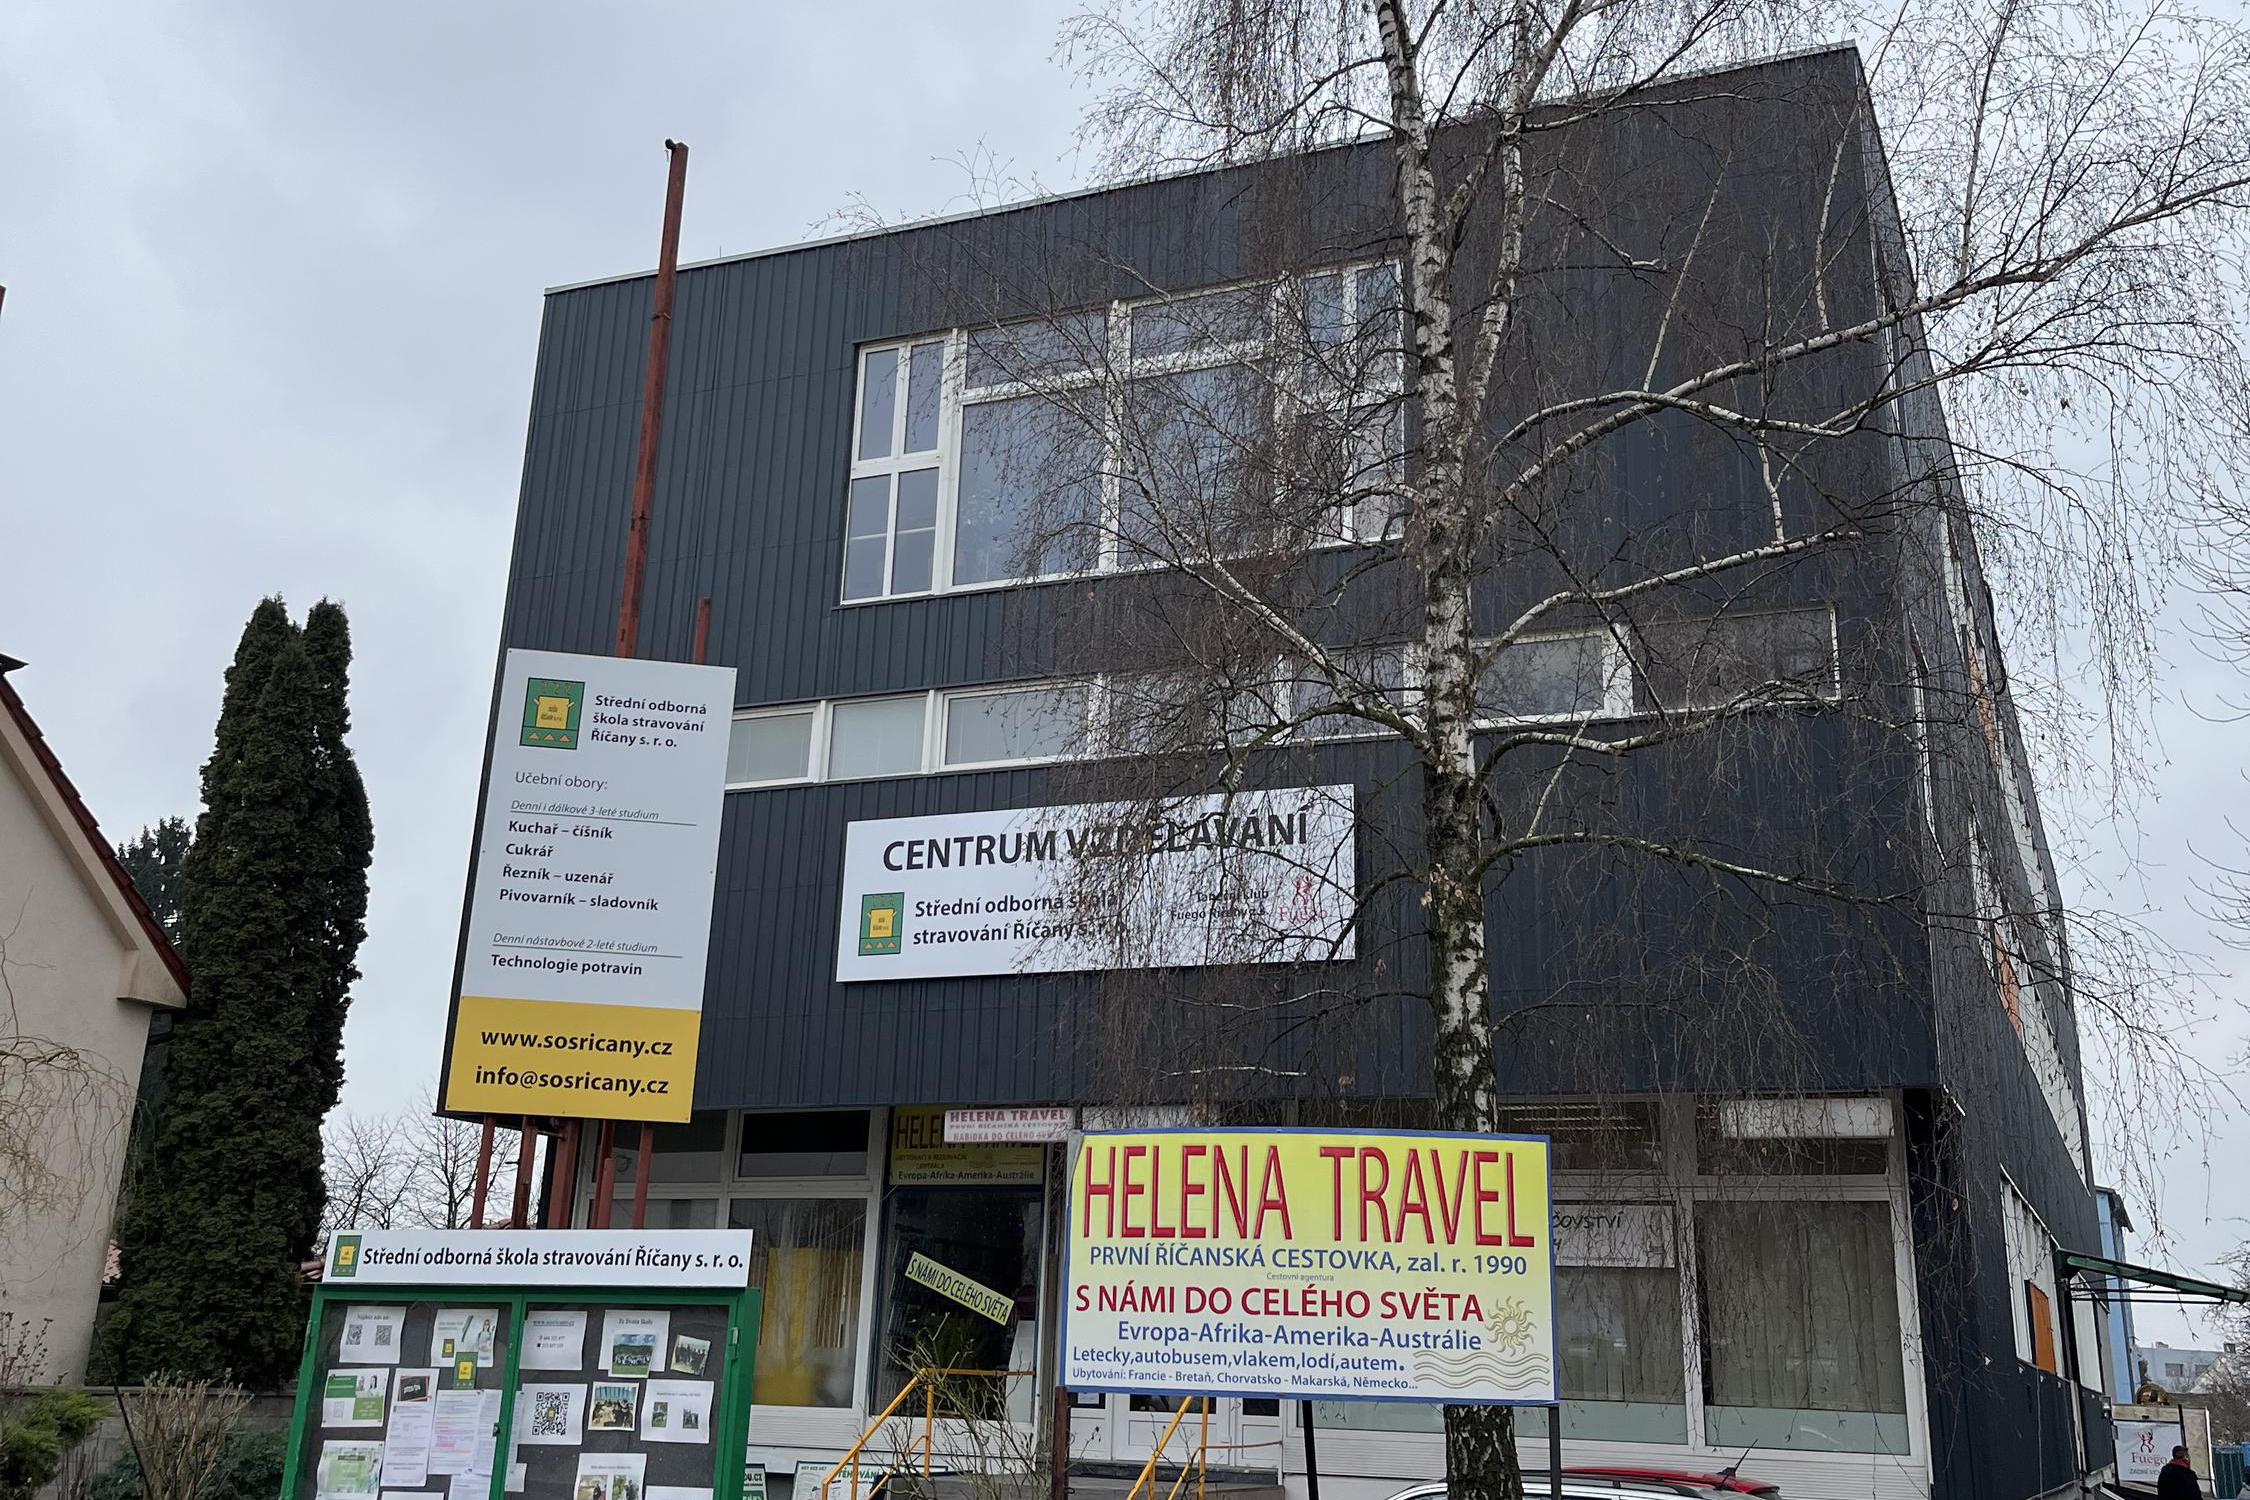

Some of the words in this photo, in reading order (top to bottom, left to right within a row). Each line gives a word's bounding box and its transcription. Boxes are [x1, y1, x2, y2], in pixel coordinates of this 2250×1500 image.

[595, 694, 645, 711] Střední
[648, 701, 707, 716] odborná
[592, 712, 629, 727] škola
[632, 716, 705, 733] stravování
[591, 729, 637, 746] Říčany
[639, 735, 650, 746] s.
[653, 736, 663, 747] r.
[665, 736, 678, 748] o.
[515, 771, 562, 787] Učební
[564, 775, 608, 792] obory:
[511, 800, 541, 812] Denní
[547, 803, 588, 816] dálkové
[589, 806, 617, 818] 3-leté
[618, 808, 659, 820] studium
[508, 820, 559, 836] Kuchař
[571, 823, 613, 839] číšník
[505, 842, 554, 858] Cukrář
[883, 830, 1056, 871] CENTRUM
[502, 866, 551, 881] Řezník
[564, 870, 615, 885] uzenář
[499, 888, 575, 906] Pivovarník
[589, 895, 659, 911] sladovník
[915, 895, 981, 918] Střední
[984, 891, 1064, 915] odborná
[912, 921, 1008, 945] stravování
[1012, 915, 1075, 941] Říčany
[493, 932, 525, 945] Denní
[526, 935, 584, 949] nástavbové
[586, 939, 615, 951] 2-leté
[616, 941, 658, 953] studium
[491, 954, 579, 973] Technologie
[581, 960, 643, 976] potravin
[480, 1031, 674, 1059] www.sosricany.cz
[475, 1065, 670, 1097] info@sosricany.cz
[950, 1110, 1006, 1123] HELENA
[1010, 1109, 1067, 1121] TRAVEL
[1083, 1145, 1293, 1241] HELENA
[1320, 1145, 1535, 1249] TRAVEL
[363, 1246, 420, 1266] Střední
[423, 1246, 492, 1266] odborná
[495, 1246, 540, 1267] škola
[542, 1247, 631, 1268] stravování
[633, 1243, 693, 1273] Říčany
[695, 1253, 709, 1269] s.
[713, 1253, 724, 1269] r.
[728, 1254, 744, 1270] o.
[1090, 1242, 1152, 1266] PRVNÍ
[1155, 1240, 1266, 1269] ŘÍČANSKÁ
[1272, 1247, 1402, 1275] CESTOVKA,
[1406, 1252, 1446, 1274] zal.
[1452, 1258, 1468, 1275] r.
[1474, 1254, 1528, 1276] 1990
[908, 1258, 918, 1275] S
[915, 1261, 940, 1286] NÁMI
[936, 1272, 952, 1293] DO
[950, 1280, 984, 1309] CELÉHO
[980, 1295, 1010, 1322] SVĚTA
[1075, 1284, 1091, 1312] S
[1098, 1278, 1176, 1314] NÁMI
[1185, 1286, 1232, 1316] DO
[1240, 1282, 1371, 1319] CELÉHO
[1379, 1286, 1485, 1323] SVĚTA
[1118, 1321, 1482, 1352] Evropa-Afrika-Amerika-Austrálie
[1072, 1368, 1127, 1383] Ubytování:
[1128, 1369, 1167, 1383] Francie
[1175, 1371, 1213, 1386] Bretaň,
[1216, 1372, 1283, 1387] Chorvatsko
[1291, 1374, 1351, 1389] Makarská,
[1352, 1376, 1419, 1391] Německo...
[2131, 1452, 2168, 1467] Fuego
